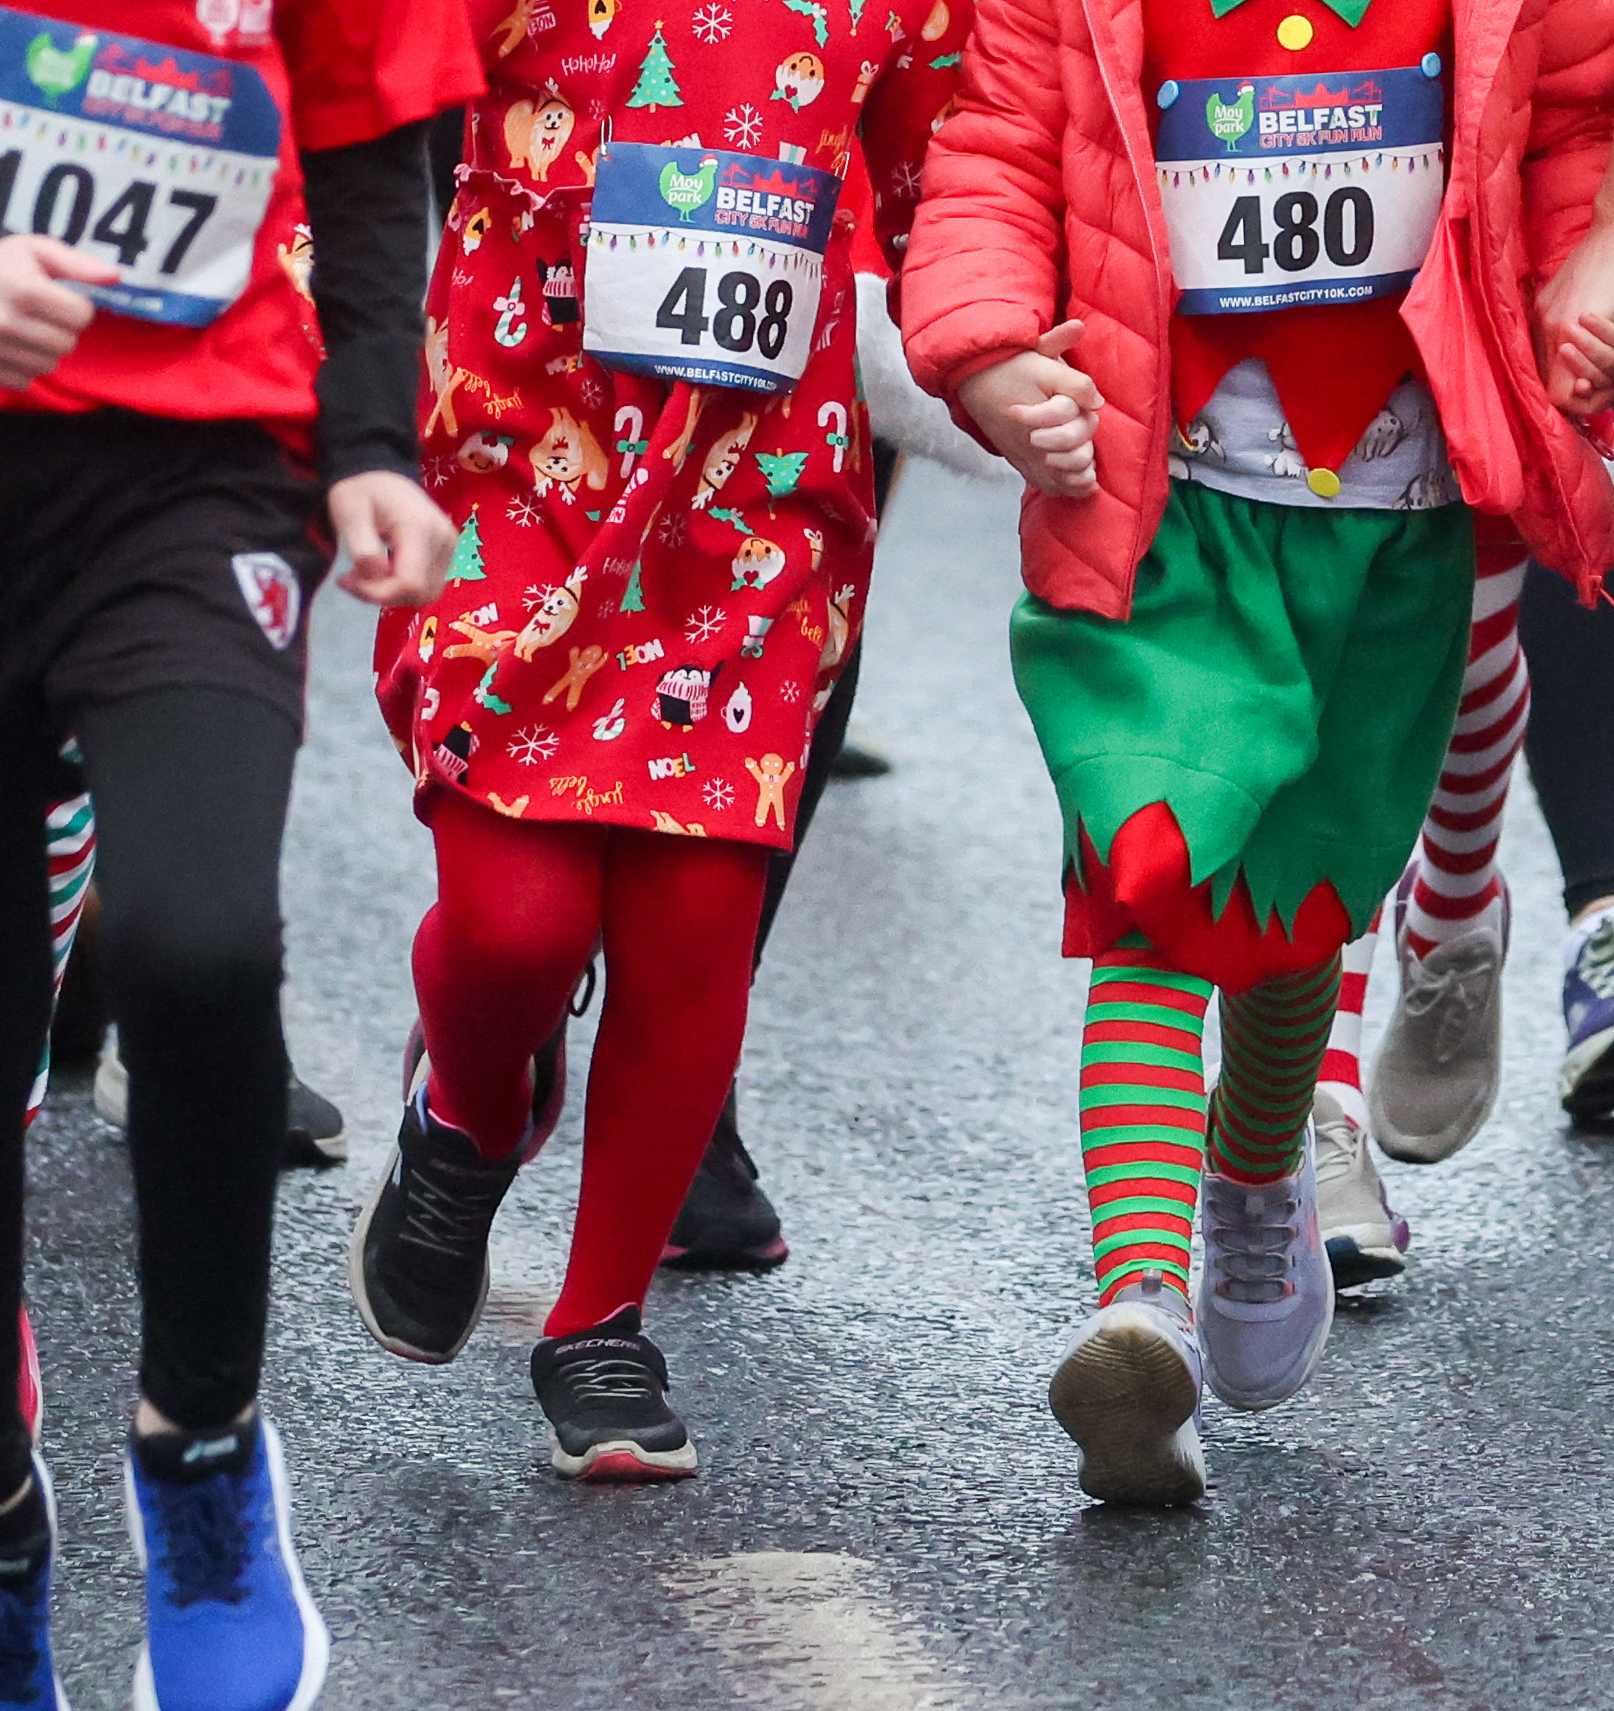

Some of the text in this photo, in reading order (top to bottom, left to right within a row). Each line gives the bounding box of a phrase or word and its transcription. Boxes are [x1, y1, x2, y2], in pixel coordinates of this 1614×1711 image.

[86, 68, 232, 124] BELFAST
[1214, 105, 1243, 122] Moy
[1259, 104, 1383, 134] BELFAST
[1213, 120, 1245, 136] park
[1259, 133, 1293, 149] CITY
[1319, 128, 1348, 145] FUN
[1351, 125, 1383, 143] RUN
[670, 173, 704, 192] Moy
[668, 190, 703, 205] park
[717, 186, 815, 224] BELFAST
[715, 210, 748, 227] CITY
[1217, 186, 1374, 274] 480
[1219, 286, 1373, 308] WWW.BELFASTCITY10K.COM
[655, 266, 793, 360] 488
[616, 639, 665, 671] NOEL
[648, 752, 696, 781] NOEL
